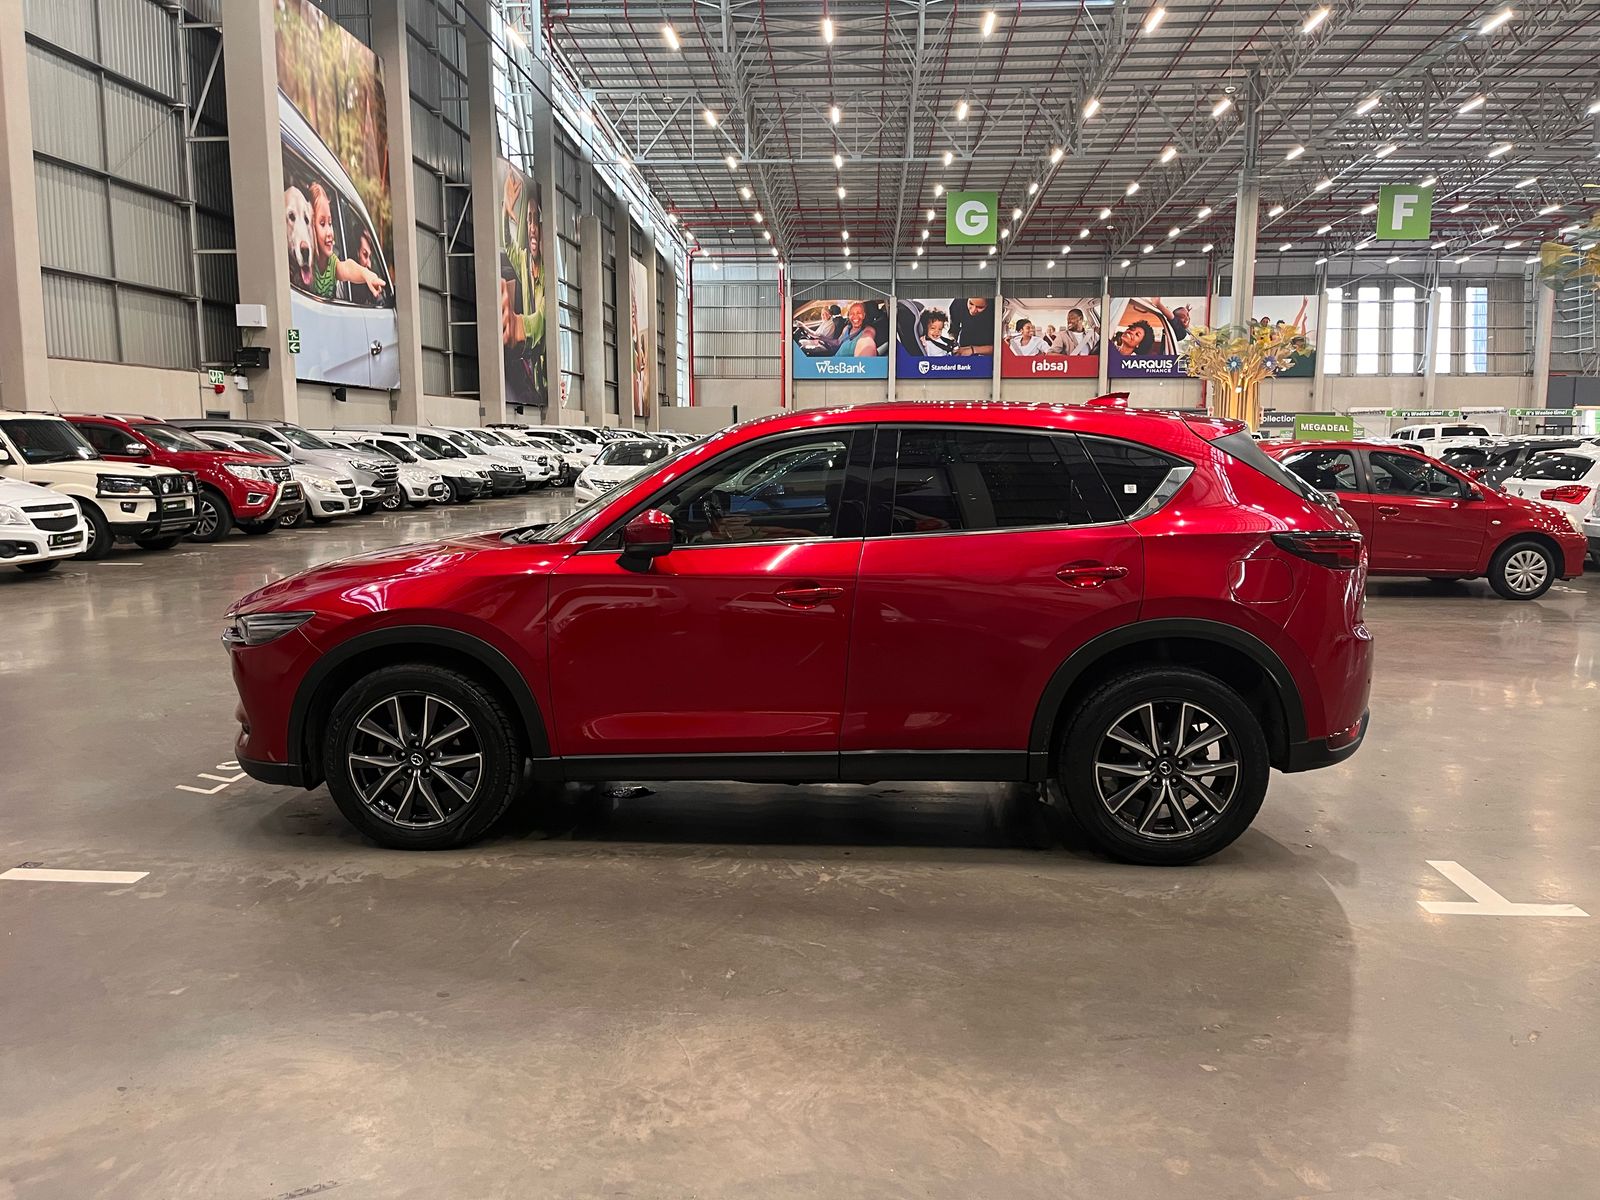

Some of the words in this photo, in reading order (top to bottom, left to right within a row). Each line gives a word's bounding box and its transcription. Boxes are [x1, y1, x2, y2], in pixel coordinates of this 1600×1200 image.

[955, 200, 989, 236] G
[1391, 194, 1419, 230] F
[815, 360, 866, 374] WesBank
[931, 363, 956, 371] Standard
[957, 363, 972, 371] Bank
[1031, 359, 1069, 374] (absa)
[1121, 359, 1173, 369] MARQUIS
[1263, 414, 1296, 423] ollection
[1300, 423, 1350, 432] MEGADEAL
